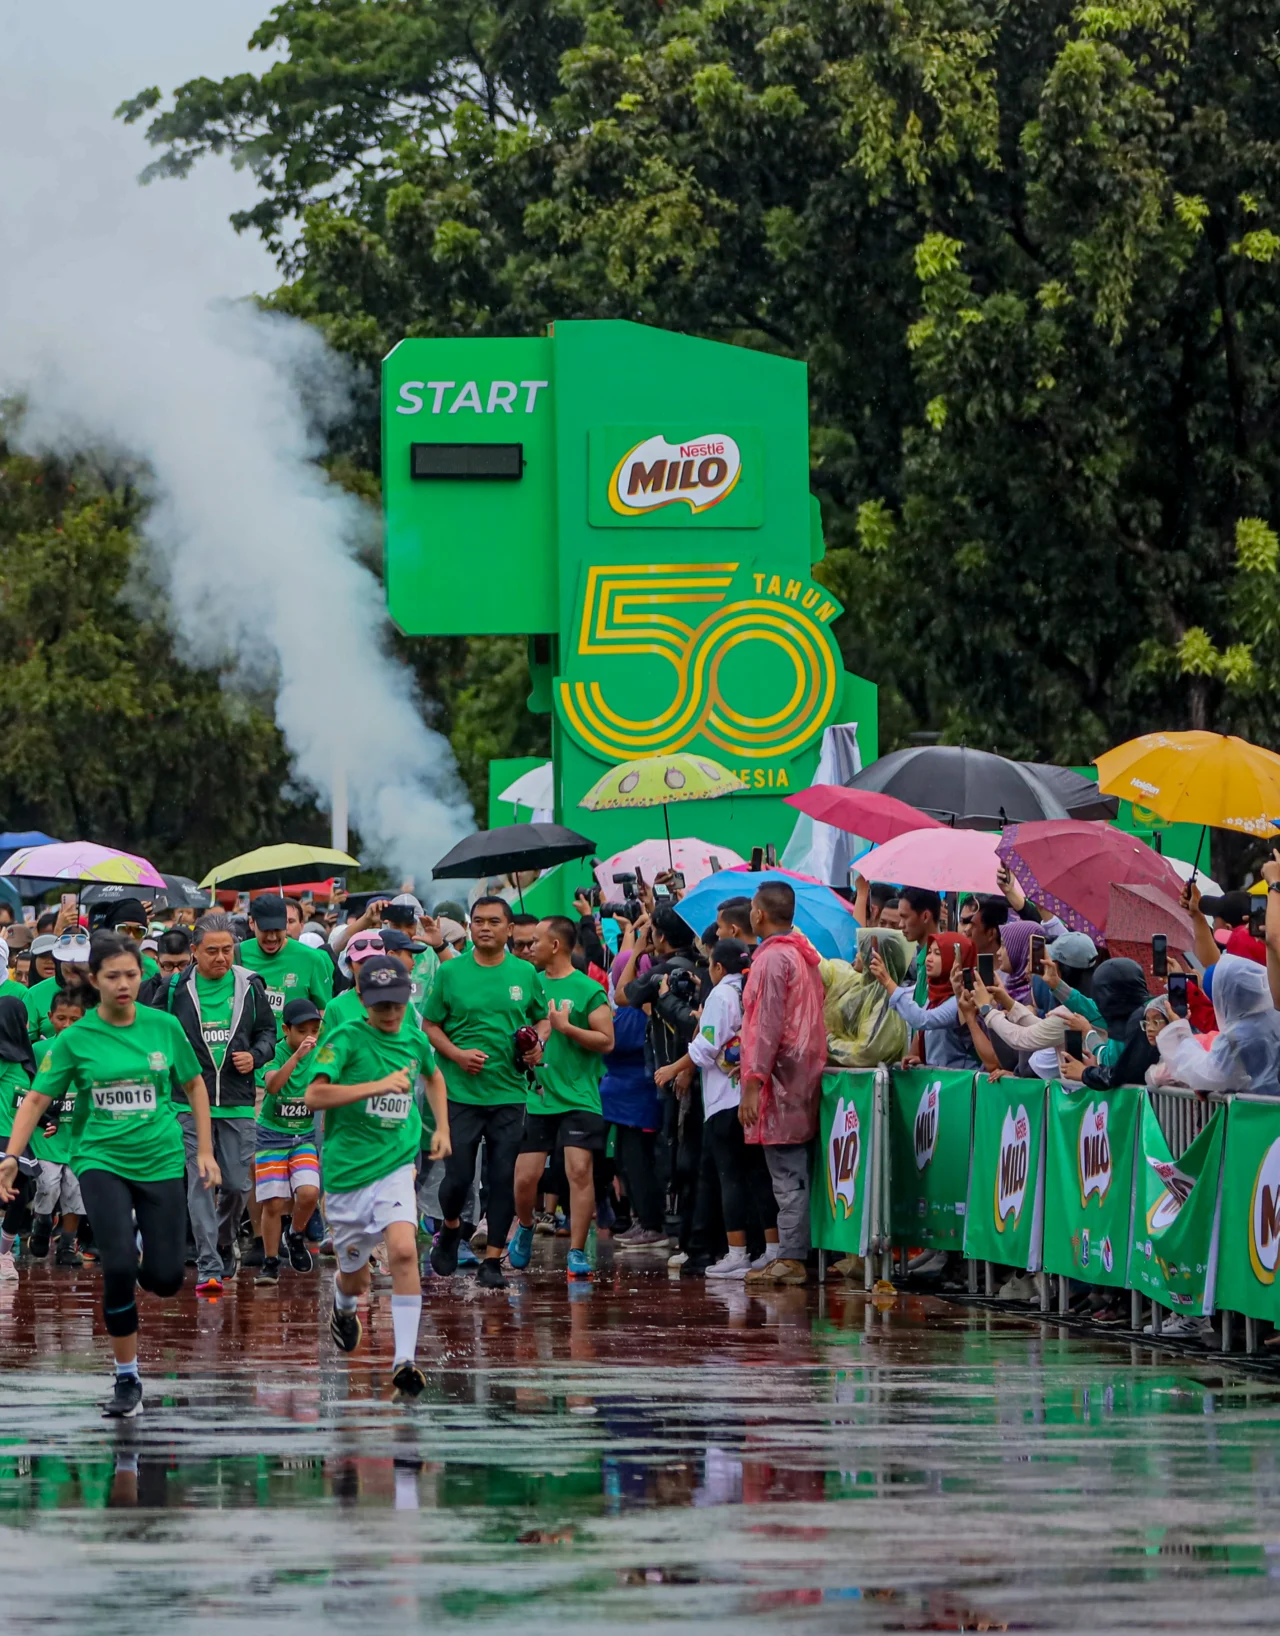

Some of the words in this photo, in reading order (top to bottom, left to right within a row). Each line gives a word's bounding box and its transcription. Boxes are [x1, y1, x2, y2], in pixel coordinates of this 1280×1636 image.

[396, 380, 548, 414] START
[627, 457, 729, 496] MILO
[753, 573, 837, 623] TAHUN
[560, 562, 836, 761] 50
[95, 1089, 153, 1106] V50016
[1001, 1140, 1027, 1201] MILO
